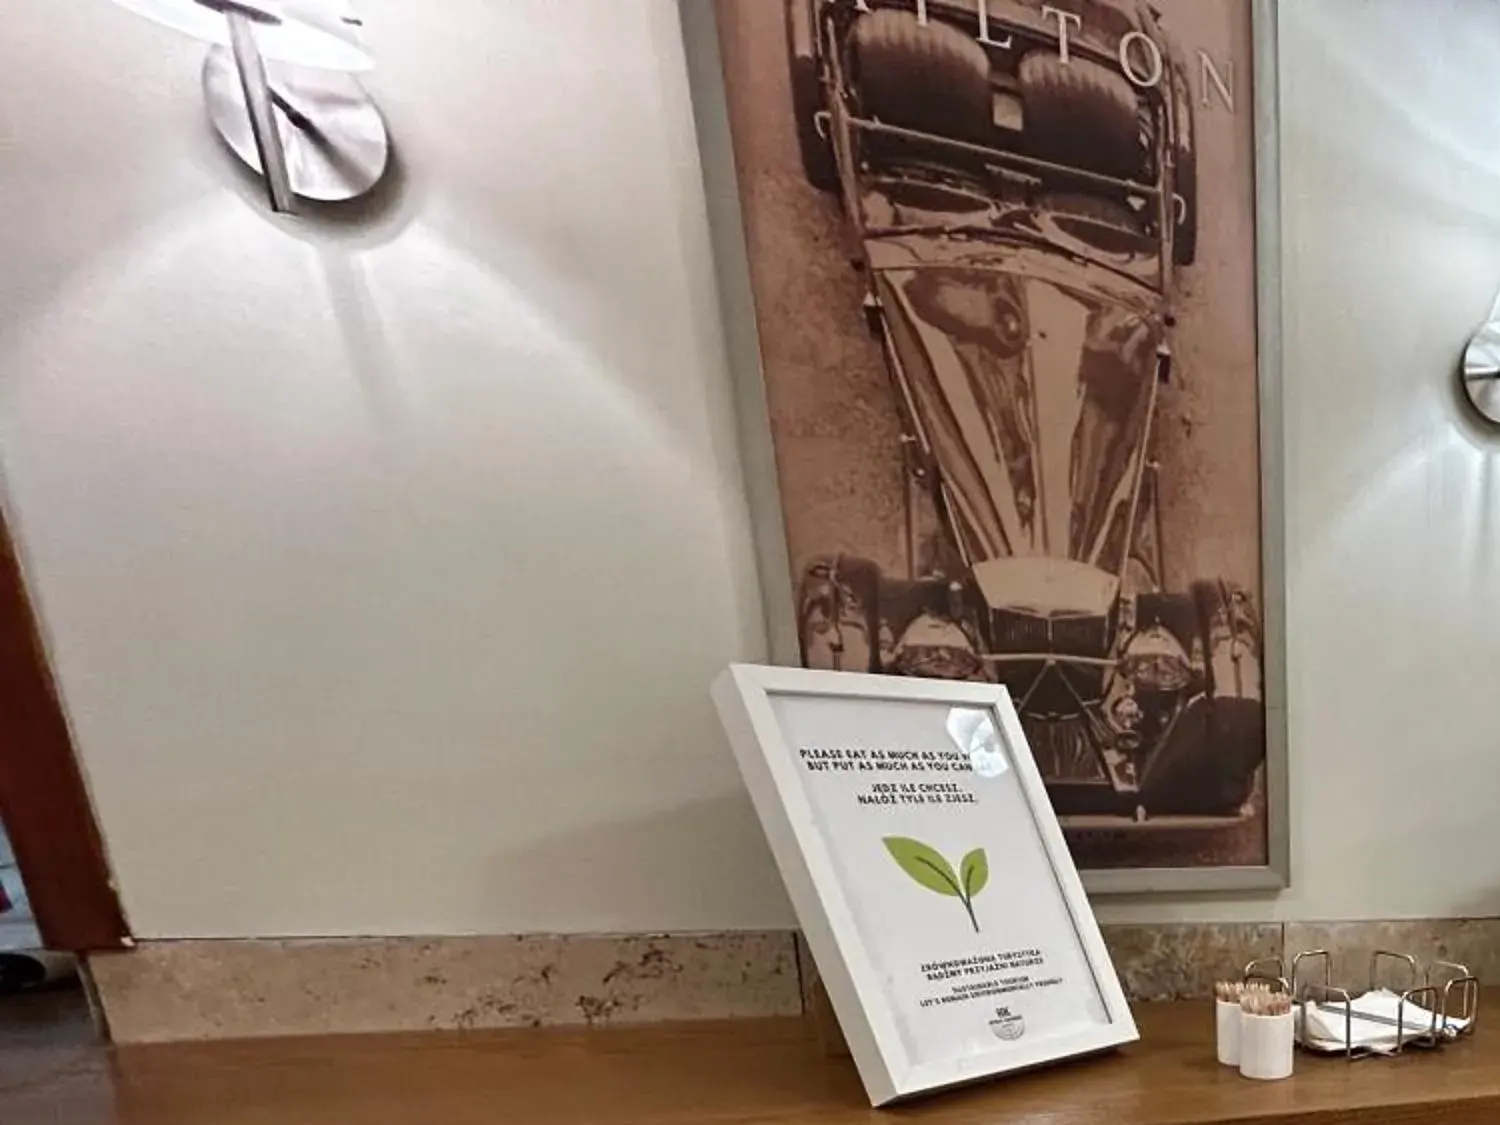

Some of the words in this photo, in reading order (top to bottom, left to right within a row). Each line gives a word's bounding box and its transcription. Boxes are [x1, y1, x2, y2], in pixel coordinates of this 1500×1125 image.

[828, 0, 1233, 113] LTON
[800, 749, 843, 760] PLEASE
[846, 750, 867, 760] EAT
[871, 750, 885, 760] AS
[888, 751, 918, 761] MUCH
[921, 751, 936, 761] AS
[939, 752, 960, 762] YOU
[807, 761, 830, 771] BUT
[833, 761, 855, 771] PUT
[859, 762, 874, 771] AS
[876, 762, 908, 771] MUCH
[911, 762, 925, 771] AS
[928, 762, 949, 771] YOU
[951, 762, 973, 772] CAN
[899, 784, 916, 793] ILE
